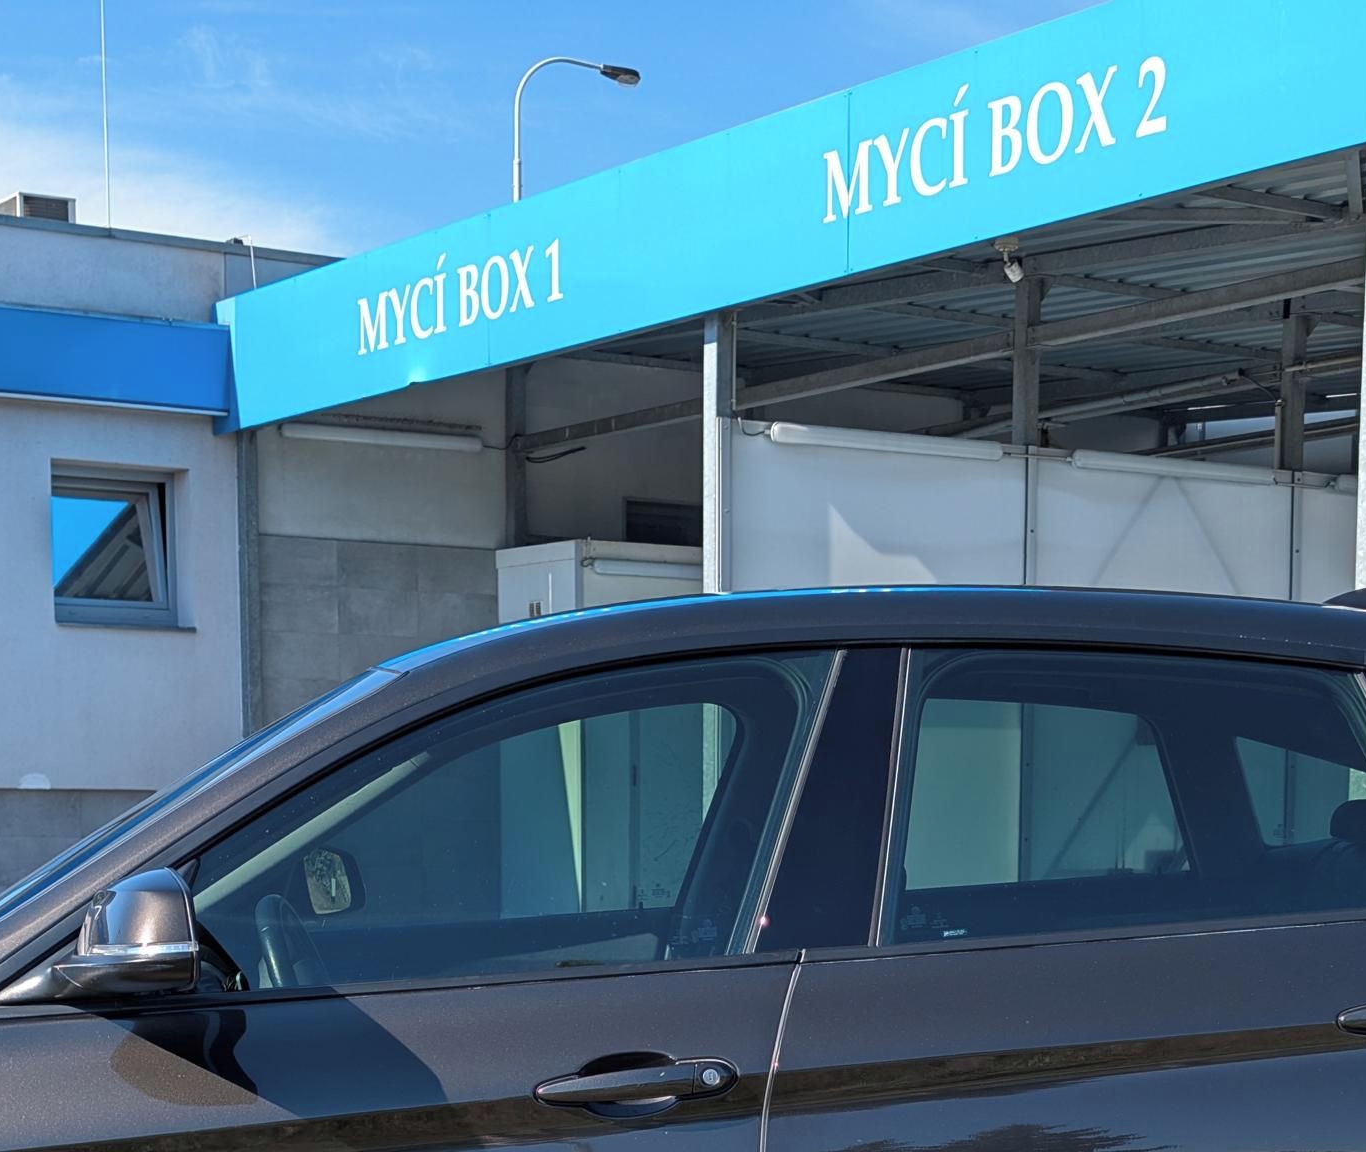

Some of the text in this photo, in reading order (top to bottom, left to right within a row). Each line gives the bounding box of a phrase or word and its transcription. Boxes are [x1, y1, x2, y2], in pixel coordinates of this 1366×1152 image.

[822, 55, 1167, 224] MYCÍ BOX 2
[357, 238, 564, 356] MYCÍ BOX 1
